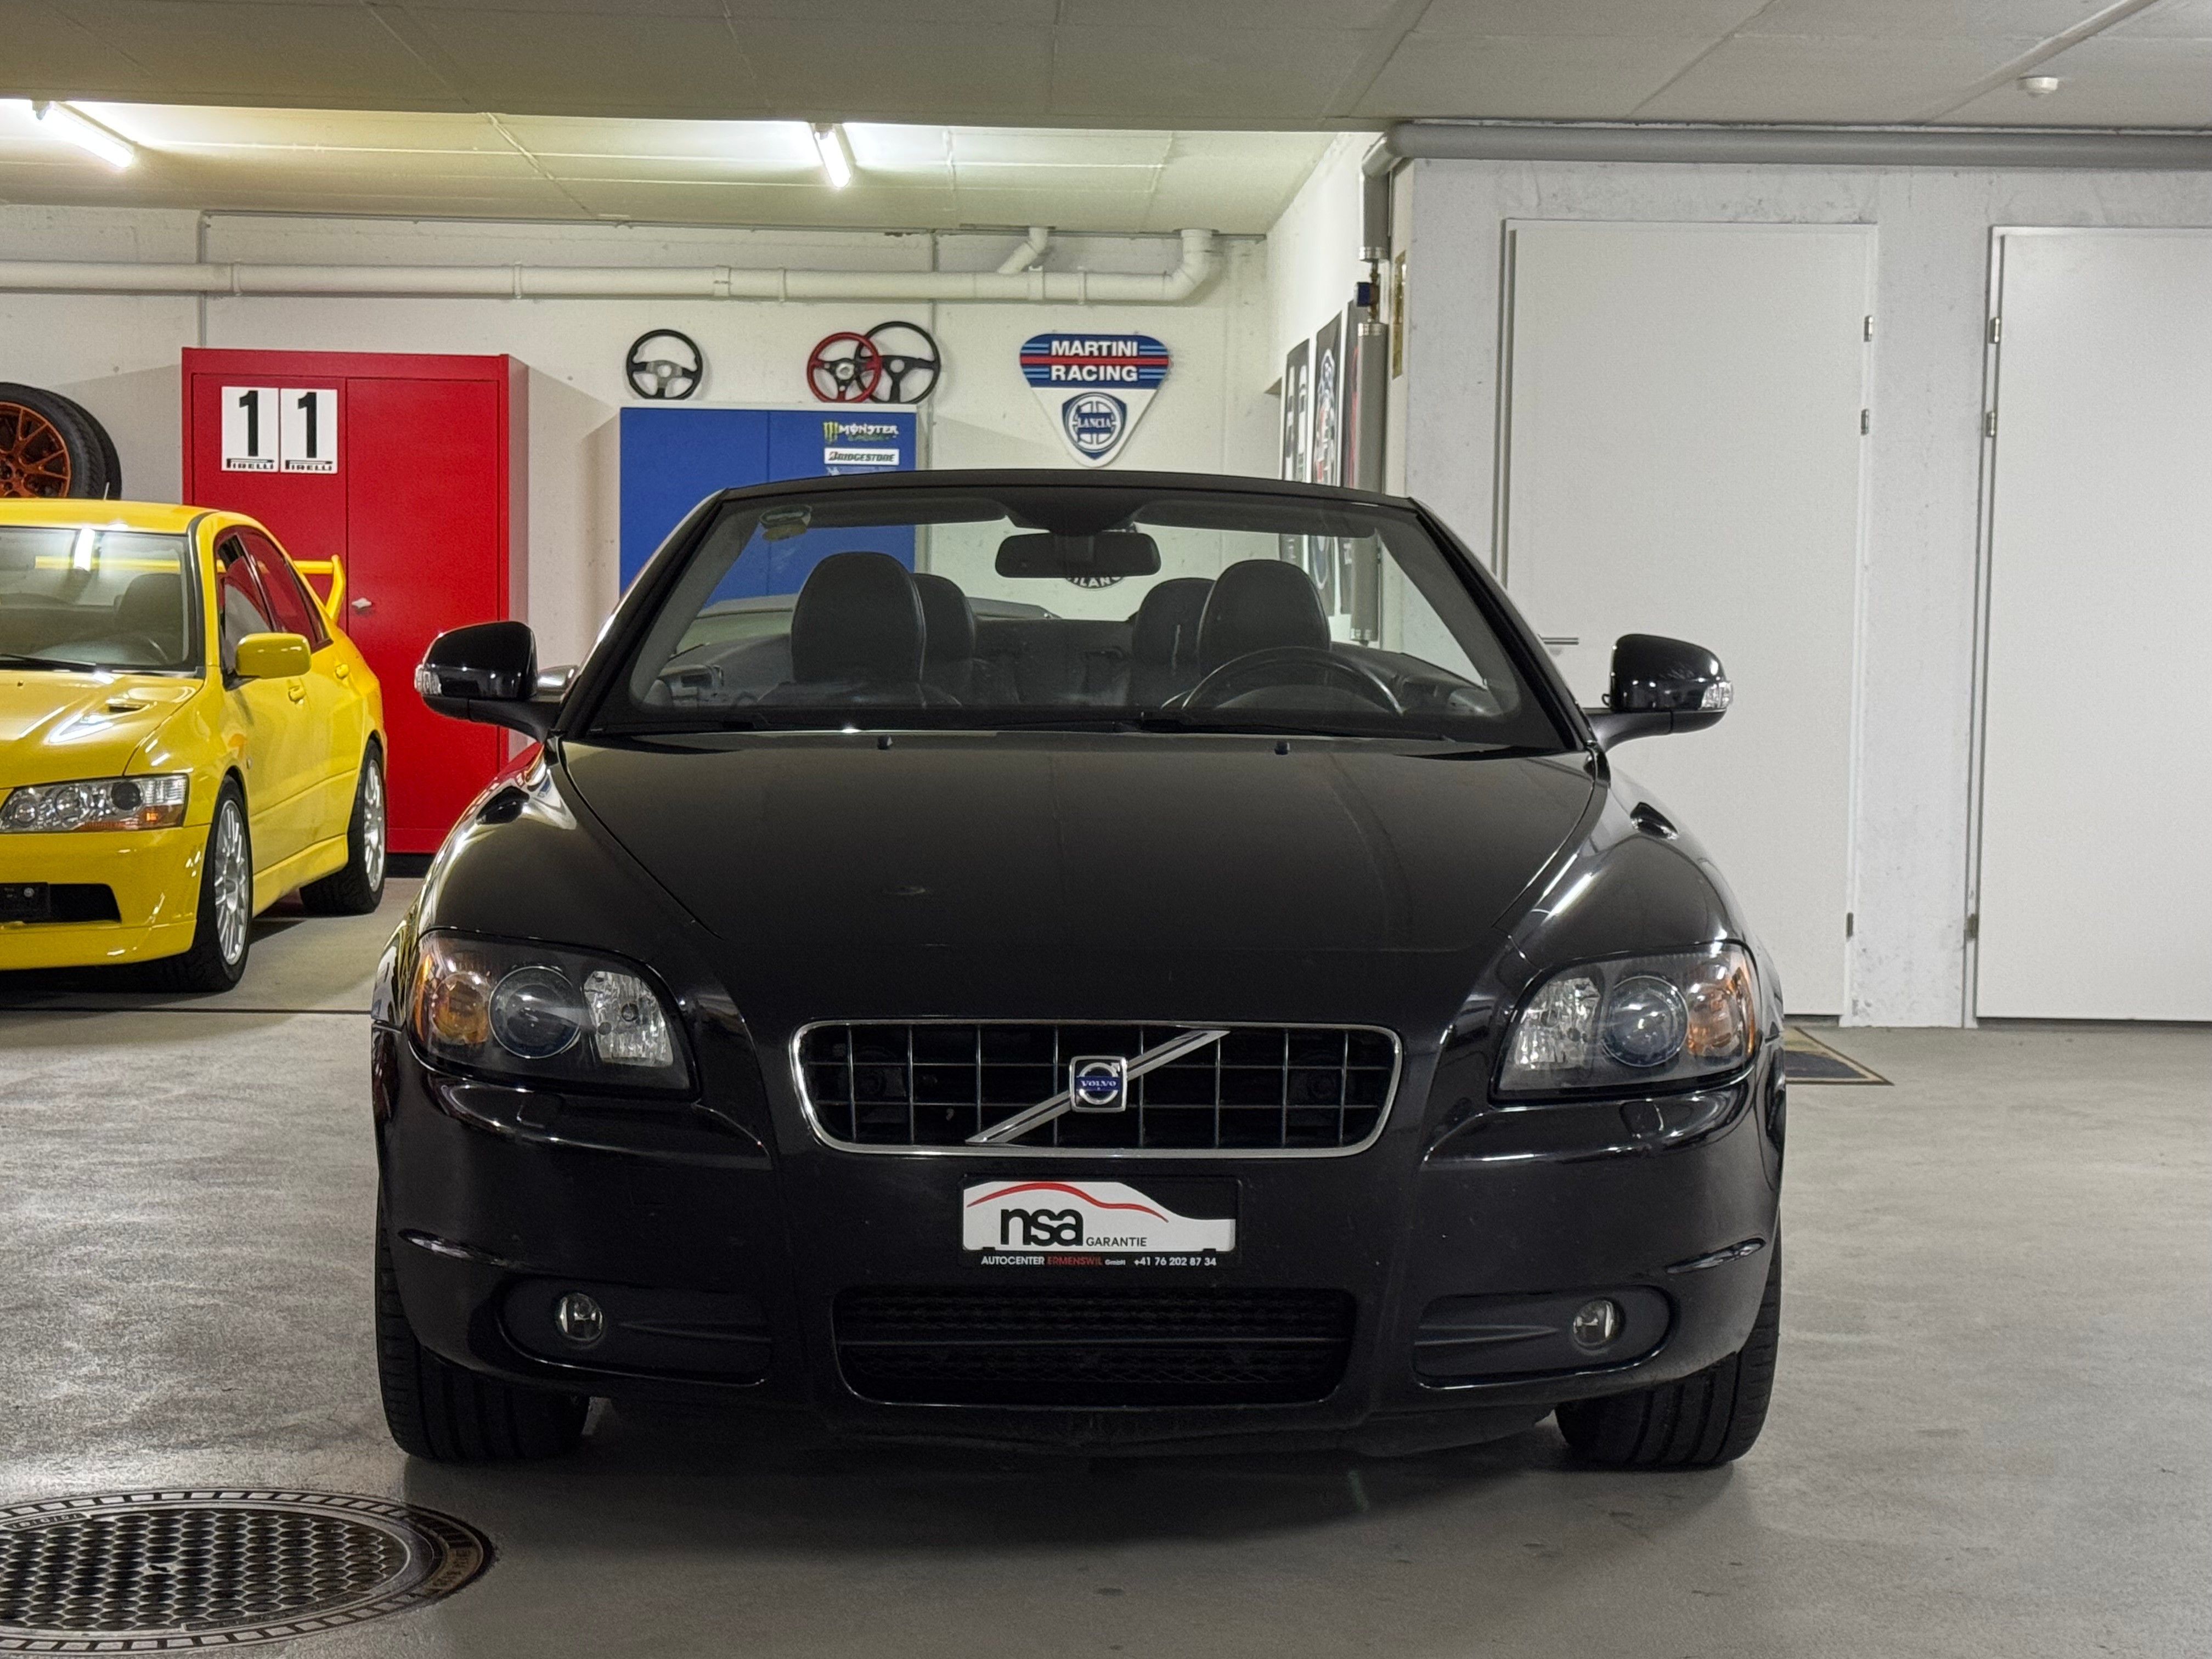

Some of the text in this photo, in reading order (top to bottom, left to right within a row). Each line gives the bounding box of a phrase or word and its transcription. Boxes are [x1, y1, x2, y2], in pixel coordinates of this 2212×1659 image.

[1051, 341, 1138, 357] MARTINI
[1051, 365, 1138, 381] RACING
[1077, 417, 1111, 428] LANCIA
[839, 423, 899, 435] MONSTER
[227, 459, 274, 470] PIRELLI
[285, 460, 333, 471] PIRELLI
[1001, 1209, 1148, 1247] nsa GARANTIE
[981, 1256, 1045, 1266] AUTOCENTER
[1047, 1256, 1102, 1266] ERMENSWIL
[1133, 1257, 1150, 1266] +41
[1155, 1257, 1167, 1266] 76
[1169, 1257, 1188, 1266] 202
[1189, 1257, 1201, 1266] 87
[1204, 1257, 1217, 1266] 34
